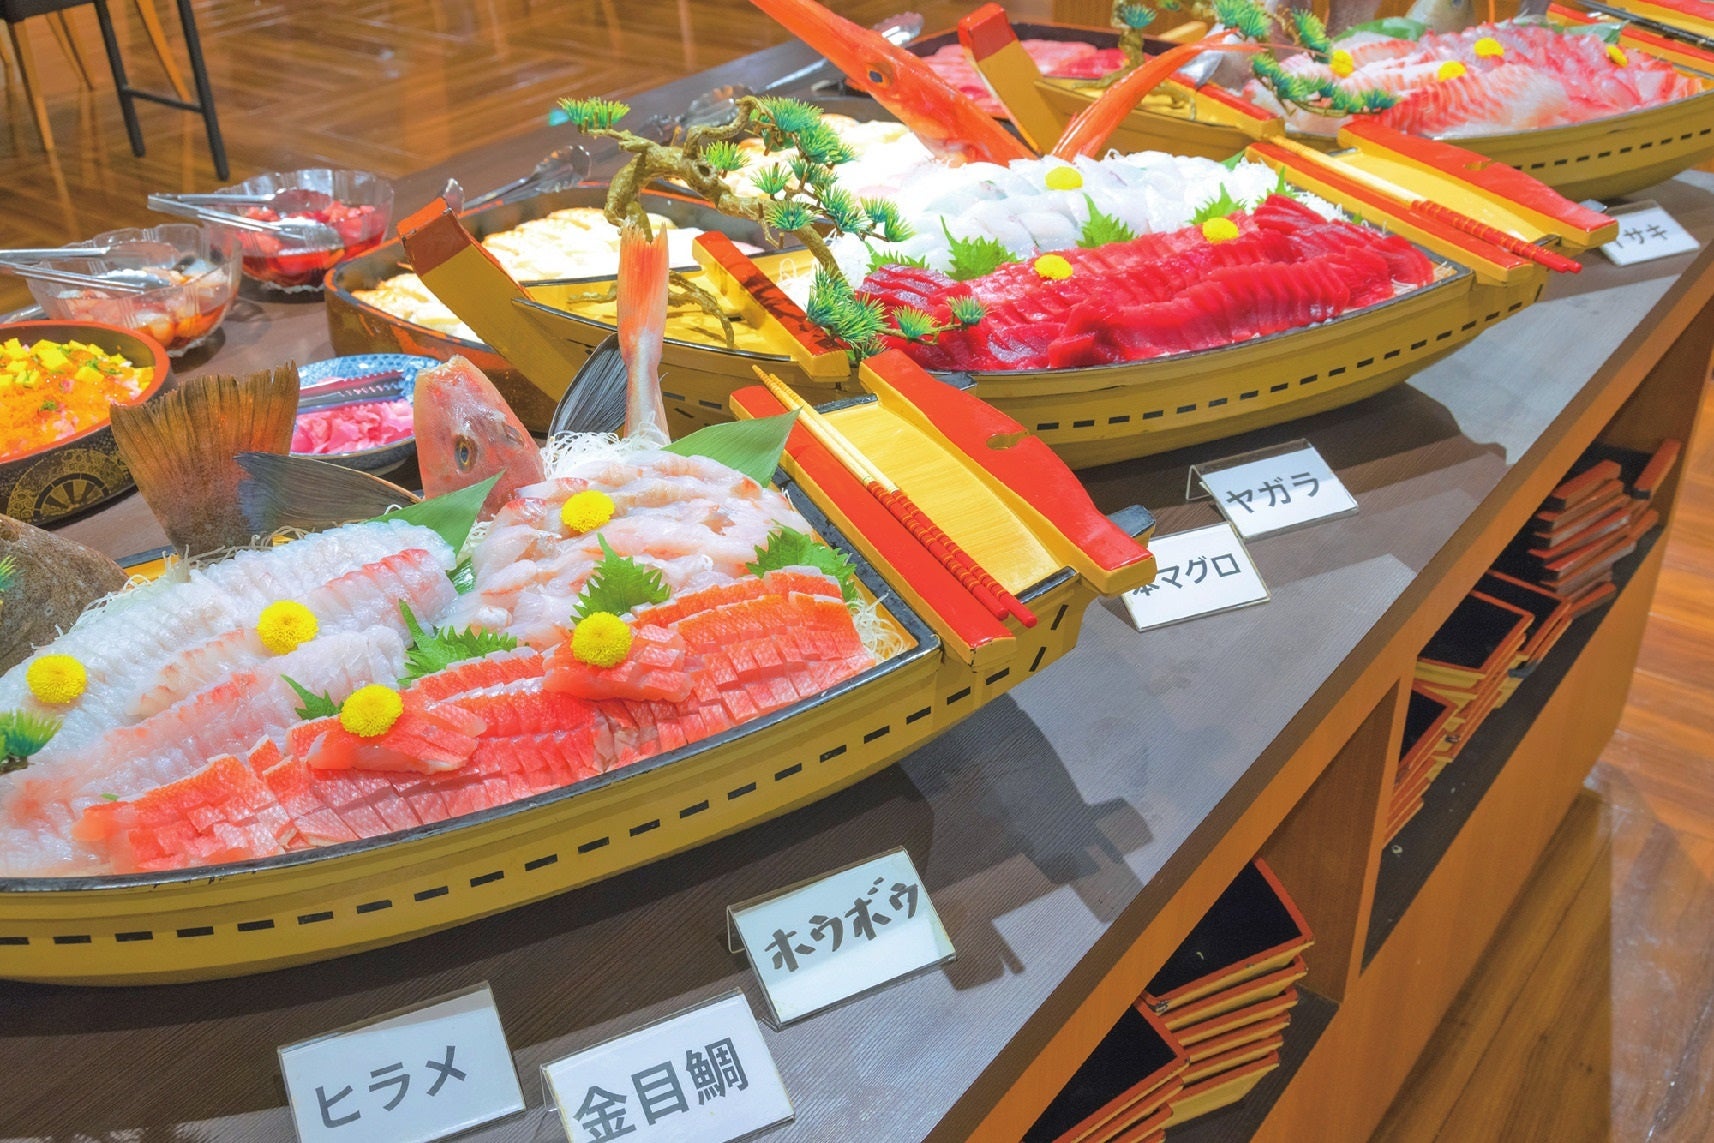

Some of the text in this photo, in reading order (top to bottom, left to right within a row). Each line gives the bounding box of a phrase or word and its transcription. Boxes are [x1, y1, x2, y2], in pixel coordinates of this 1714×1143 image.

[1616, 224, 1668, 249] サキ
[1226, 472, 1320, 513] ヤガラ
[764, 876, 919, 973] ホウボウ
[315, 1045, 467, 1129] ヒラメ
[573, 1037, 749, 1143] 金目鯛
